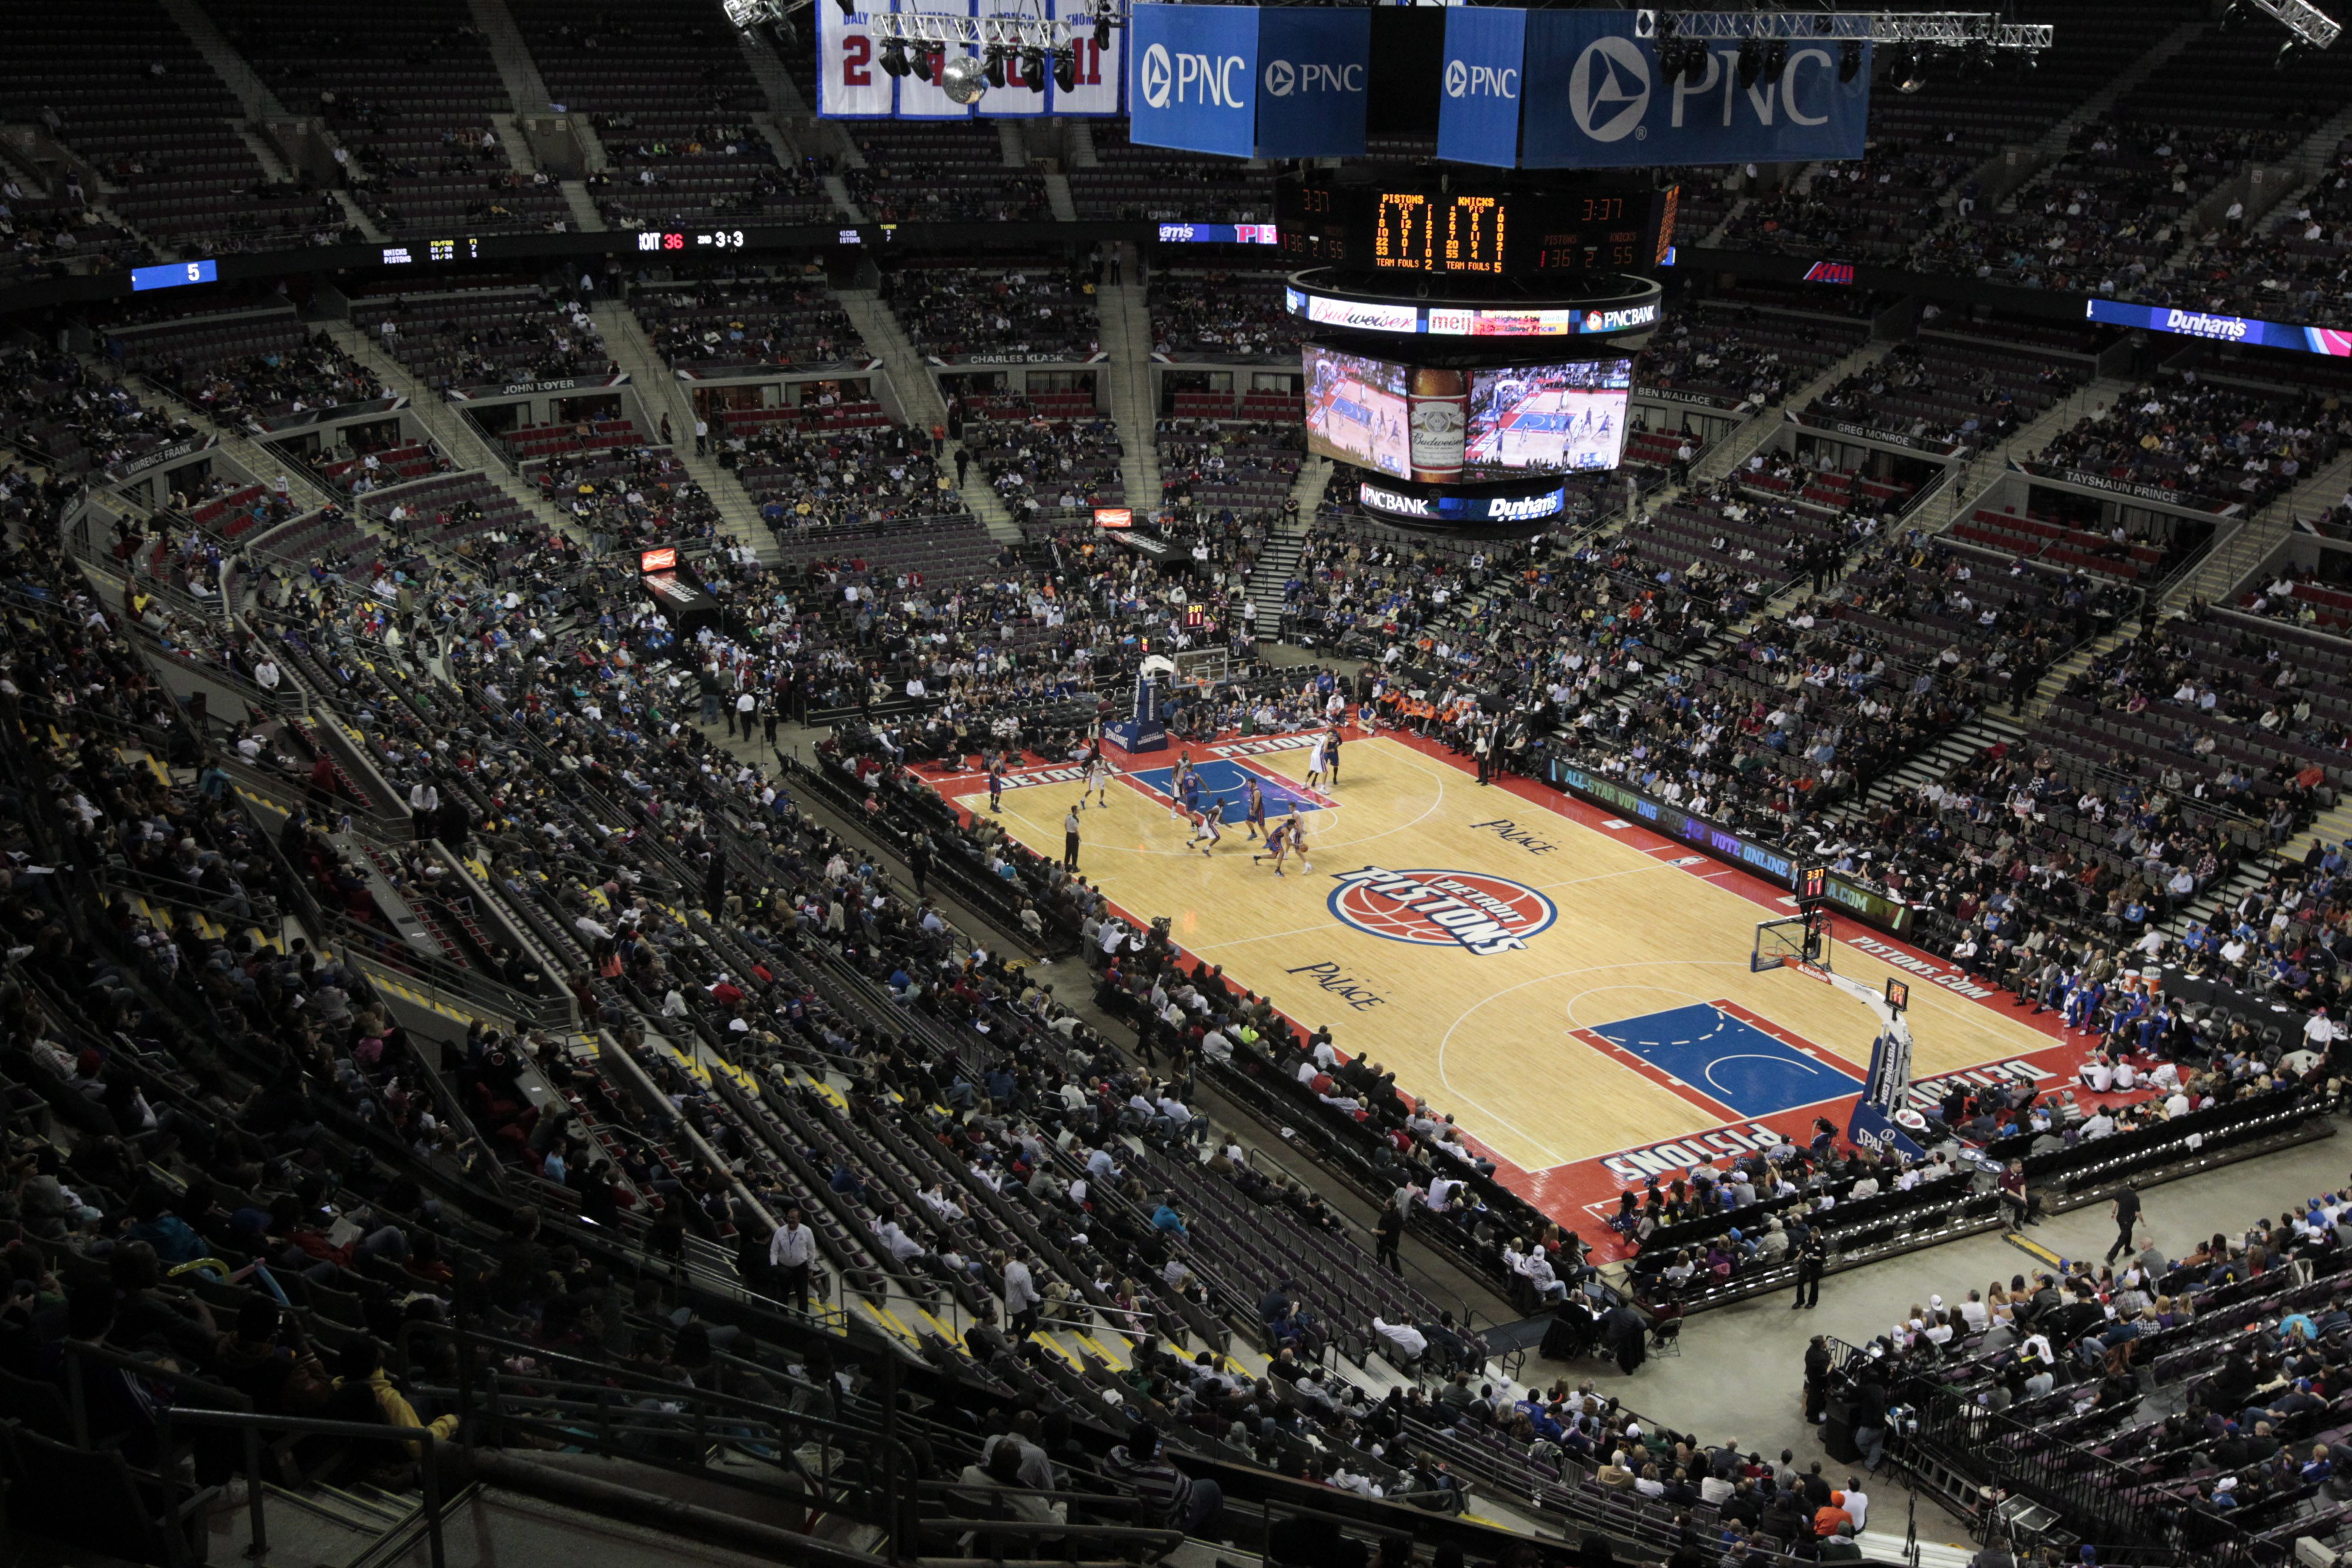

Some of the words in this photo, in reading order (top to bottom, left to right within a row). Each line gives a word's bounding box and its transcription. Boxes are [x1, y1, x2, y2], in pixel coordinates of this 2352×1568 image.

[843, 11, 868, 25] DALY
[1066, 12, 1095, 26] THOM
[843, 35, 871, 86] 2
[1072, 37, 1101, 85] 11
[1176, 53, 1245, 108] PNC
[1300, 64, 1362, 92] PNC
[1471, 66, 1517, 98] PNC
[1672, 49, 1828, 128] PNC
[1303, 189, 1329, 212] 3:37
[1382, 193, 1424, 205] PISTONS
[1458, 196, 1495, 207] KNICKS
[1379, 209, 1385, 218] 7
[1402, 210, 1409, 219] 5
[1428, 211, 1431, 220] 1
[1449, 212, 1456, 221] 2
[1472, 213, 1479, 222] 8
[1497, 213, 1504, 223] 0
[1582, 199, 1622, 220] 3:37
[1160, 223, 1194, 238] am's
[1378, 219, 1385, 228] 8
[1401, 219, 1412, 229] 12
[1425, 220, 1432, 230] 2
[1449, 222, 1456, 230] 6
[1472, 222, 1478, 231] 6
[1497, 223, 1504, 232] 0
[663, 233, 684, 249] 36
[697, 236, 712, 245] 2ND
[716, 231, 744, 248] 3:3
[1378, 228, 1389, 237] 10
[1402, 229, 1408, 238] 9
[1425, 230, 1432, 239] 2
[1449, 231, 1456, 240] 7
[1471, 232, 1480, 241] 11
[1496, 232, 1504, 242] 0
[1545, 235, 1577, 245] PISTONS
[1610, 232, 1636, 242] KNICKS
[1291, 234, 1303, 252] 36
[1376, 237, 1388, 246] 22
[1401, 238, 1408, 248] 0
[1427, 239, 1431, 248] 1
[1446, 240, 1459, 249] 20
[1471, 241, 1478, 250] 9
[1496, 242, 1503, 251] 2
[383, 248, 407, 256] KNICKS
[383, 256, 412, 264] PISTONS
[1376, 246, 1388, 256] 33
[1403, 248, 1406, 256] 1
[1425, 248, 1432, 258] 0
[1446, 249, 1458, 259] 55
[1471, 250, 1478, 259] 4
[1498, 251, 1501, 260] 1
[1552, 249, 1571, 267] 36
[1586, 251, 1593, 268] 2
[1614, 246, 1632, 264] 55
[1376, 258, 1394, 267] TEAM
[1398, 259, 1419, 268] FOULS
[1425, 259, 1432, 270] 2
[1446, 261, 1465, 270] TEAM
[1468, 262, 1490, 271] FOULS
[1494, 262, 1502, 273] 5
[187, 263, 201, 282] 5
[1312, 300, 1413, 328] Budweiser
[2166, 309, 2247, 337] Dunham's
[2174, 328, 2240, 342] SPORTS
[971, 355, 1023, 364] CHARLES
[503, 383, 534, 394] JOHN
[537, 379, 574, 390] LOYER
[1638, 387, 1659, 397] BEN
[1662, 390, 1710, 405] WALLACE
[1412, 432, 1463, 446] Budweiser
[1838, 423, 1863, 436] GREG
[1866, 429, 1909, 446] MONROE
[125, 453, 163, 474] LAWRENCE
[164, 443, 192, 460] FRANK
[2066, 472, 2132, 493] TAYSHAUN
[2134, 485, 2179, 503] PRINCE
[1488, 492, 1558, 517] Dunham's
[1498, 510, 1555, 521] SPORTS
[1188, 604, 1202, 613] 3:37
[1190, 613, 1200, 625] 11
[1105, 727, 1128, 749] SPALDING
[1137, 734, 1165, 745] BASKETBALL
[983, 763, 1122, 790] DETROT
[1469, 819, 1558, 855] PALACE
[1565, 770, 1615, 803] ALL-STAR
[1618, 791, 1658, 822] VOTING
[1711, 831, 1741, 858] VOTE
[1743, 847, 1789, 878] ONLINE
[1826, 882, 1868, 912] A.COM
[1807, 868, 1824, 881] 3:37
[1807, 880, 1822, 896] 11
[1436, 880, 1526, 924] DETROIT
[1330, 866, 1528, 955] PISTONS
[1847, 935, 1994, 999] PISTONS.COM
[1285, 961, 1386, 1011] PALACE
[1855, 985, 1872, 996] SPALDING
[1880, 1041, 1896, 1106] PISTONS.COM
[1599, 1123, 1793, 1181] PISTONS
[1856, 1128, 1912, 1164] SPALNG
